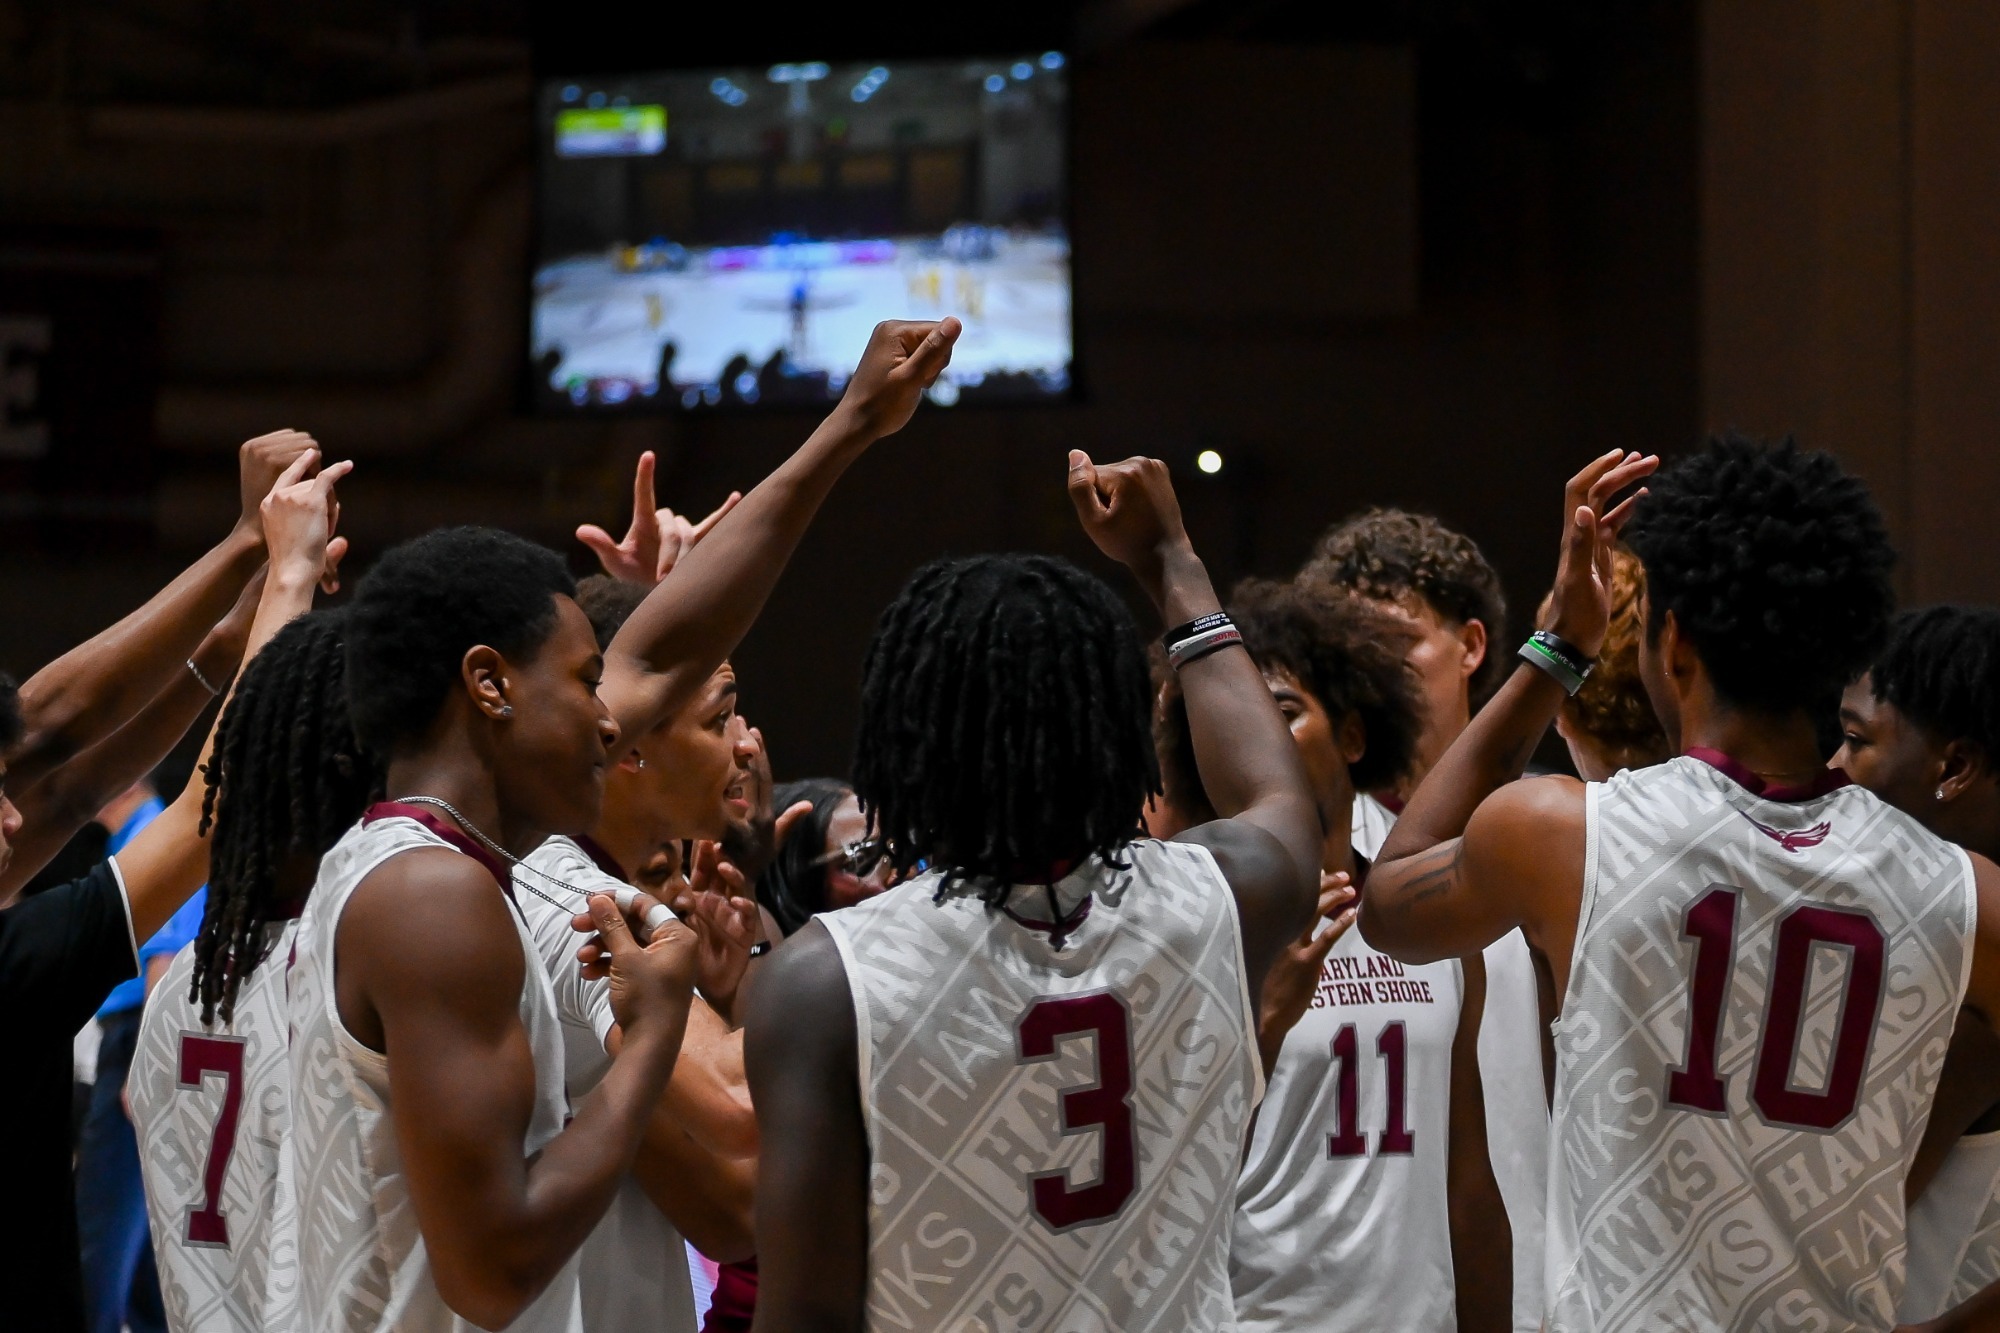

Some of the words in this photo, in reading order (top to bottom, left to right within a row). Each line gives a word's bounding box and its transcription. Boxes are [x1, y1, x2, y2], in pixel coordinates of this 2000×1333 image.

[1309, 982, 1375, 1010] STERN
[1375, 979, 1434, 1004] SHORE
[1320, 955, 1405, 982] ARYLAND
[1663, 883, 1890, 1135] 10
[177, 1030, 248, 1250] 7
[1016, 986, 1140, 1236] 3
[1326, 1020, 1415, 1160] 11
[1583, 1138, 1717, 1328] AWKS
